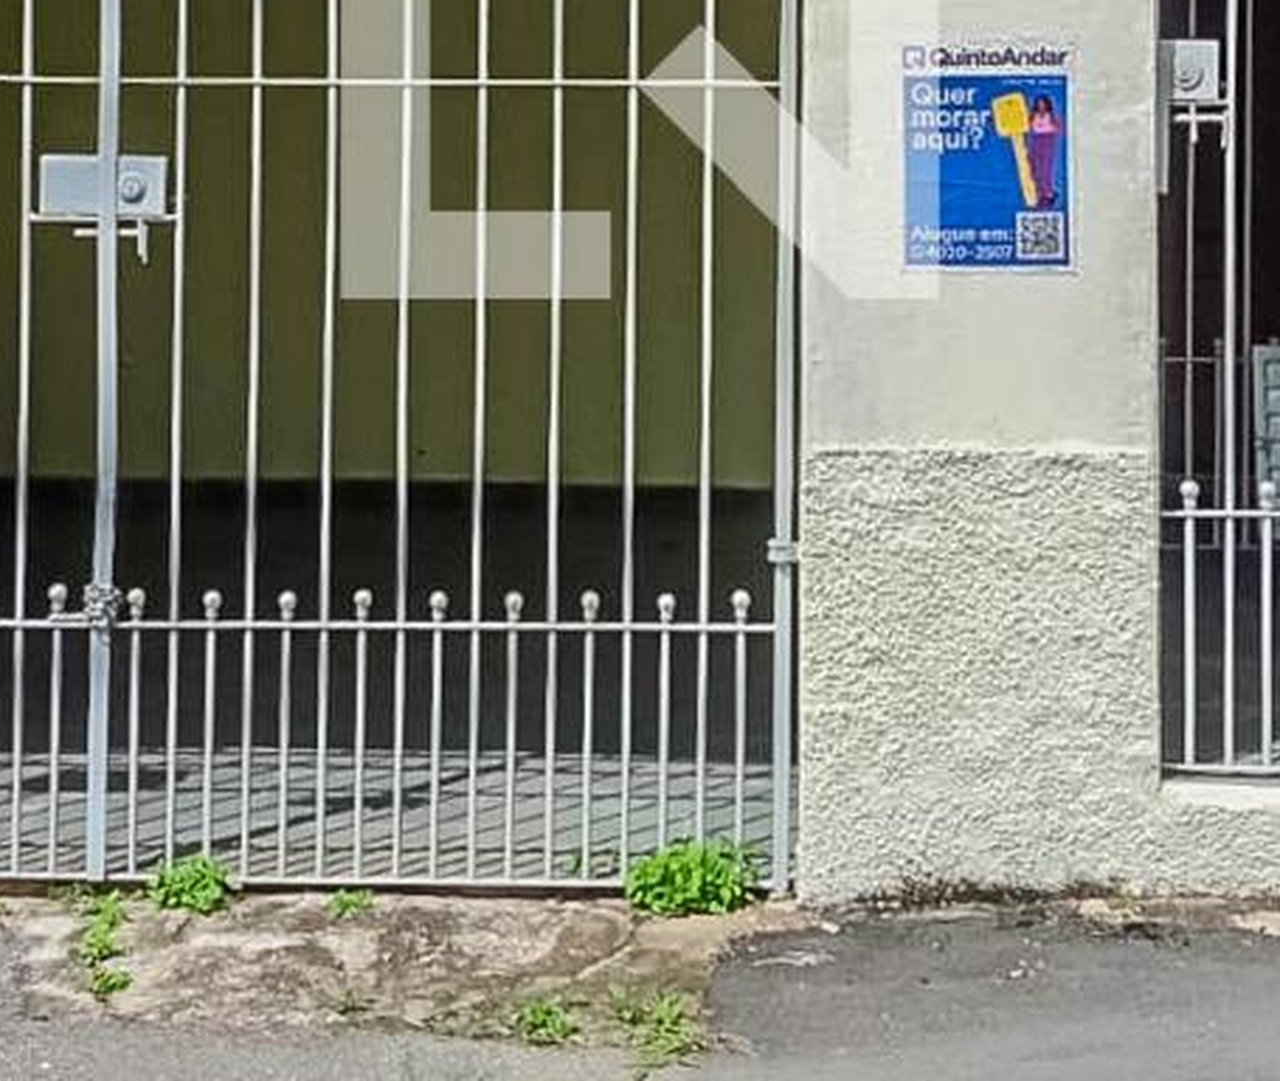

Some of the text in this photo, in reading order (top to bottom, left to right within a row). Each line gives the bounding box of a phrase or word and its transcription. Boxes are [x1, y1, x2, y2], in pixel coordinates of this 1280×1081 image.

[930, 47, 1067, 67] QuintoAndar
[911, 83, 976, 105] Quer
[911, 109, 990, 127] morar
[912, 127, 984, 154] aqui?
